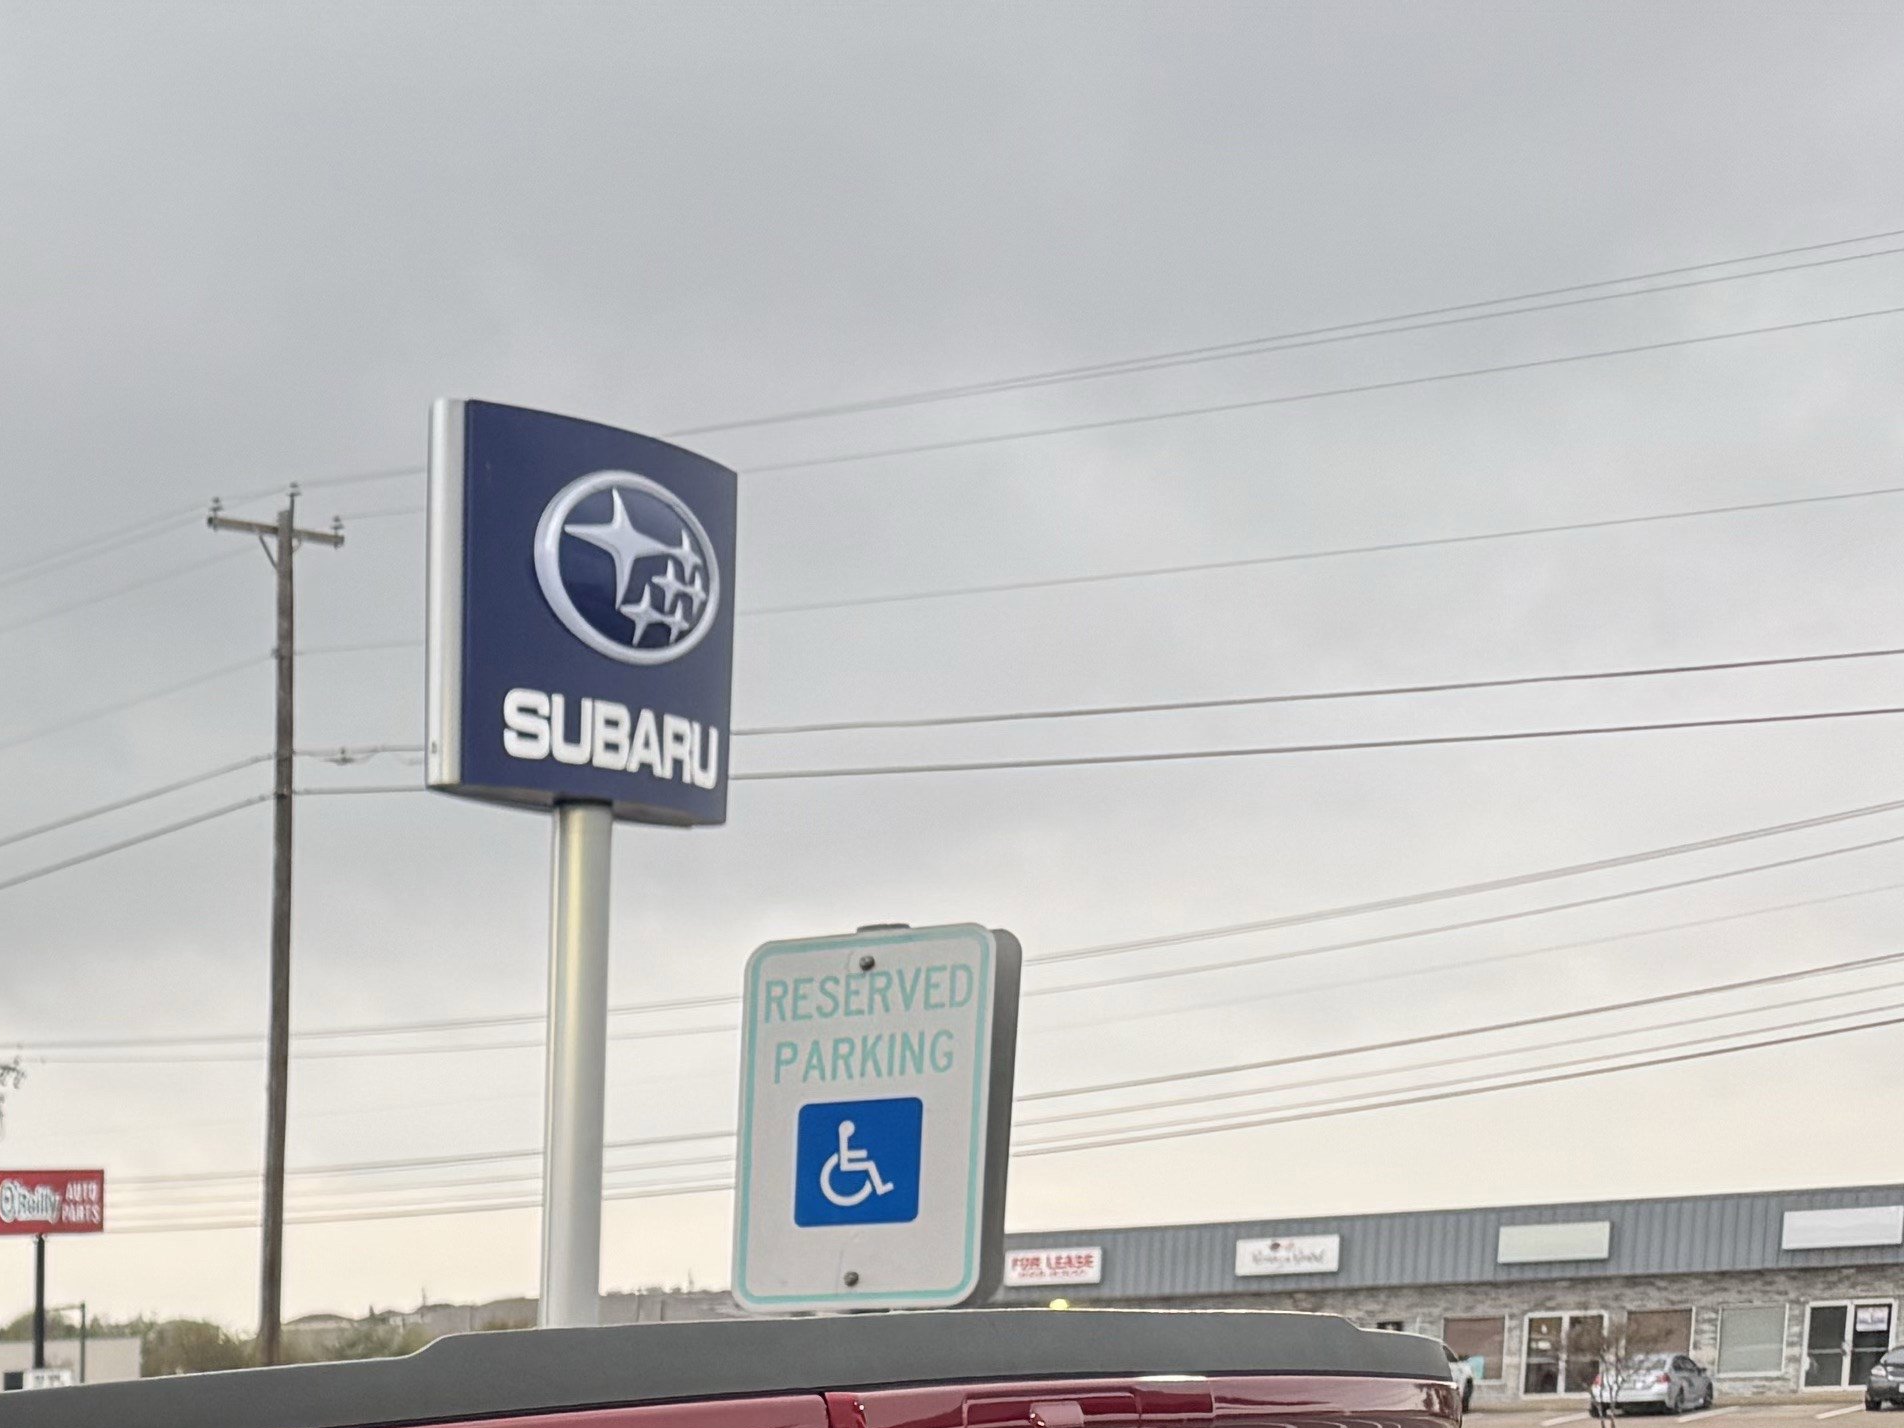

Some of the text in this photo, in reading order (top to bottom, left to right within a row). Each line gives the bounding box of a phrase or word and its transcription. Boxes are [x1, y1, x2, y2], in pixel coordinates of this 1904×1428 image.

[503, 687, 719, 791] SUBARU
[763, 963, 975, 1024] RESERVED
[772, 1029, 955, 1084] PARKING
[61, 1203, 101, 1224] PARTS
[65, 1181, 97, 1201] AUTO
